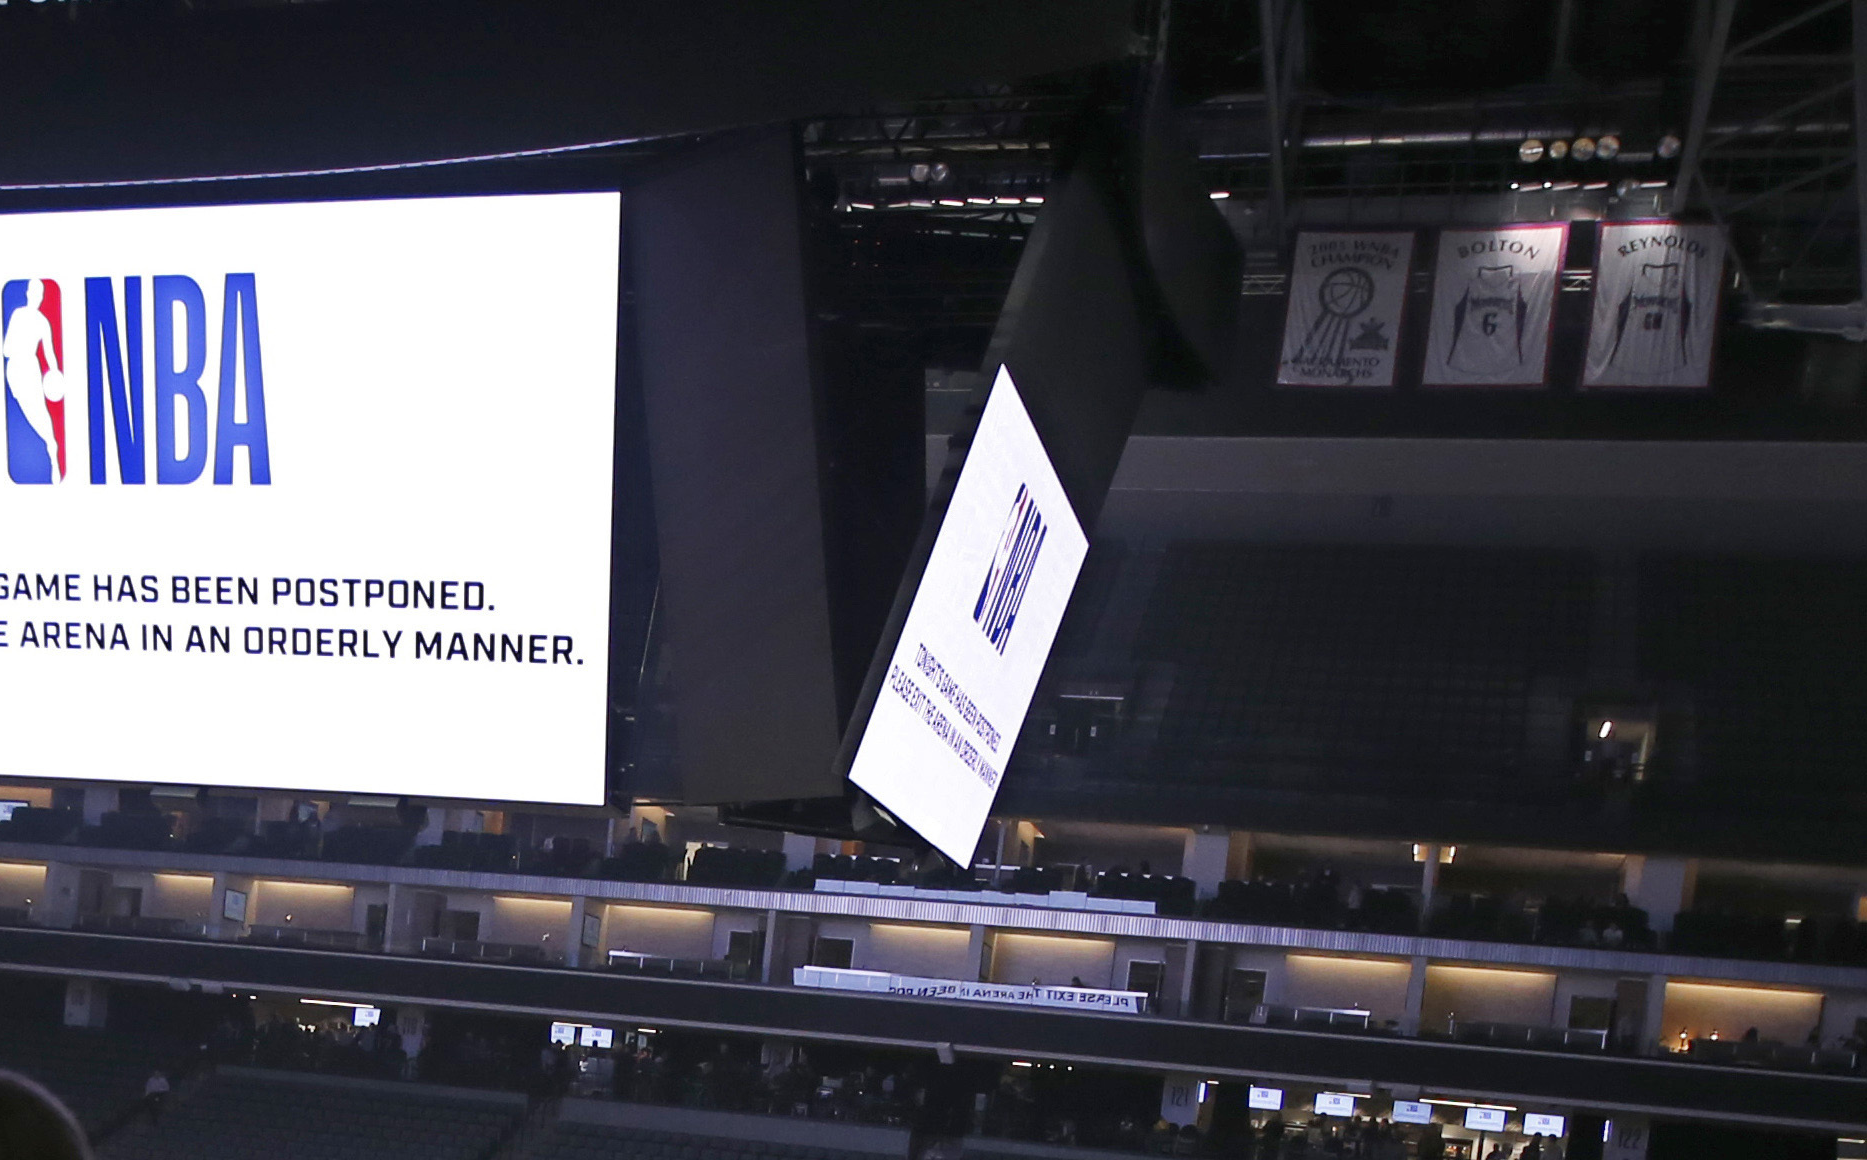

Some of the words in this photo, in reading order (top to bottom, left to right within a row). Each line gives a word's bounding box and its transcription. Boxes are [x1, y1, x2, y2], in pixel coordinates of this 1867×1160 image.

[1310, 250, 1393, 273] CHAMPION
[1457, 238, 1541, 260] BOLTON
[1616, 236, 1708, 259] REYNOLDS
[1482, 311, 1499, 336] 6
[83, 272, 272, 487] NBA
[93, 574, 159, 603] HAS
[171, 575, 259, 605] BEEN
[272, 577, 495, 611] POSTPONED.
[981, 496, 1049, 657] NBA
[20, 621, 130, 651] ARENA
[141, 624, 173, 652] IN
[185, 625, 231, 654] AN
[243, 626, 403, 659] ORDERLY
[415, 630, 584, 666] MANNER.
[888, 664, 914, 703] PLEASE
